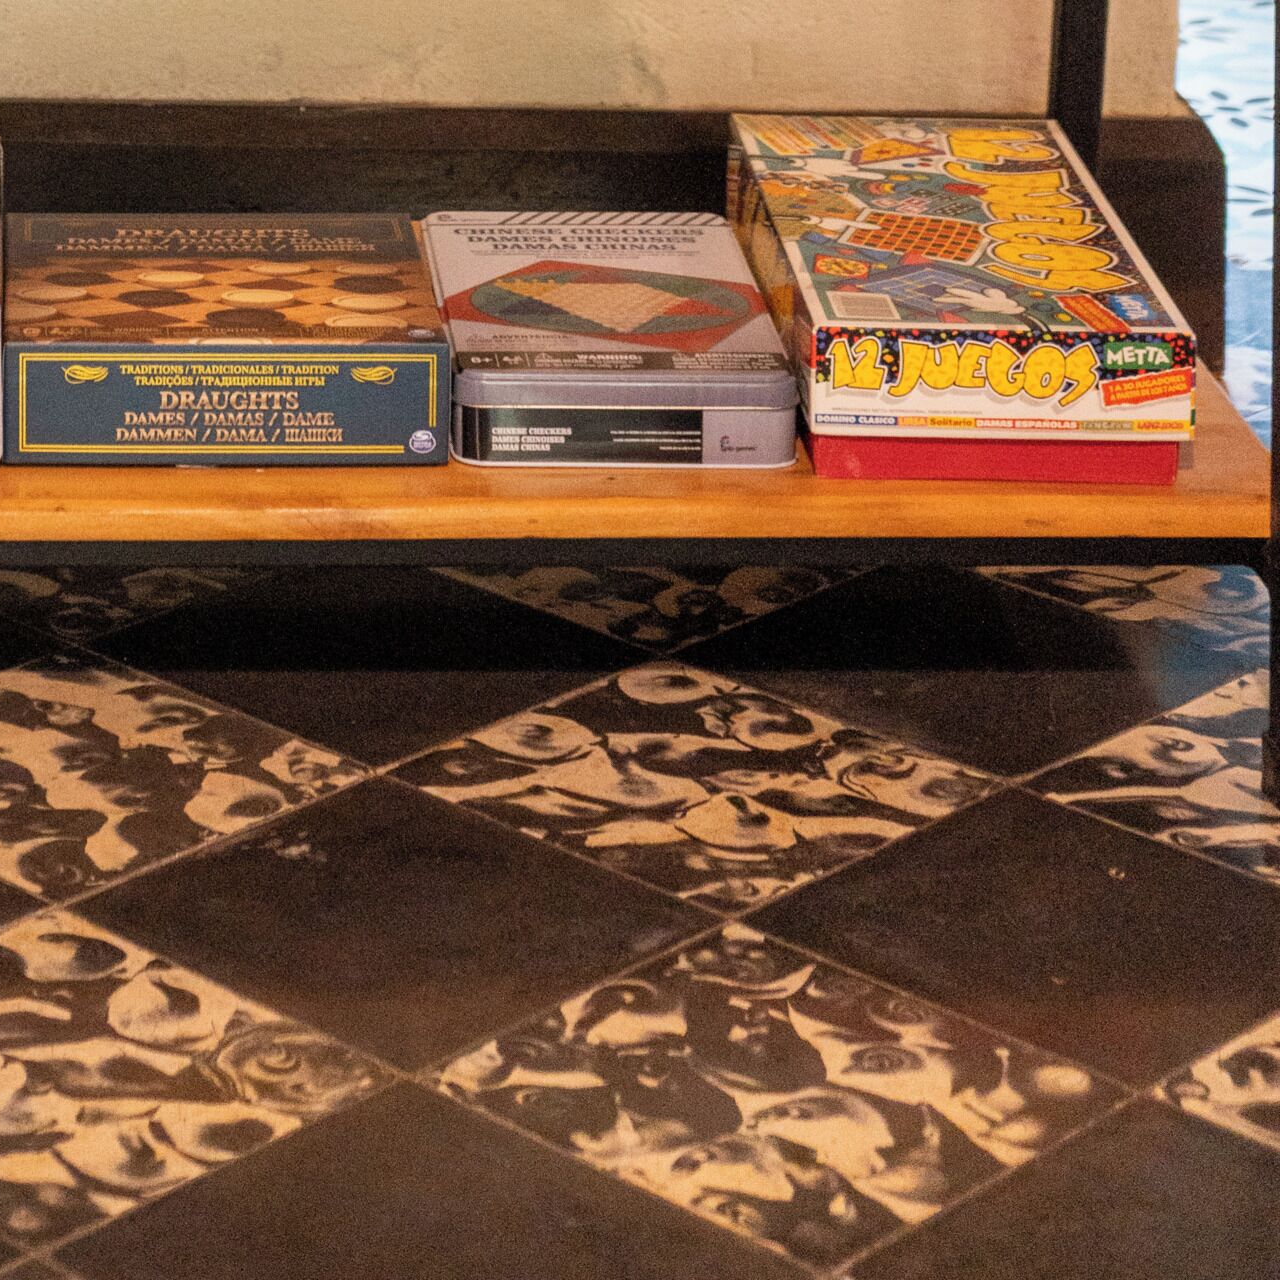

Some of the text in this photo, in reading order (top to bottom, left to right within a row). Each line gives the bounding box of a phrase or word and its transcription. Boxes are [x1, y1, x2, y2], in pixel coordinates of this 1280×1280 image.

[454, 227, 704, 236] CHINESE CHECKERS
[585, 243, 676, 251] CHINAS
[1106, 346, 1170, 366] METTA
[120, 365, 184, 375] TRADITIONS
[192, 365, 274, 375] TRADICIONALES
[282, 366, 339, 375] TRADITION
[830, 339, 1097, 408] 12 JUEGOS
[134, 374, 193, 387] TRADIÇÕES
[294, 377, 325, 386] ИГРЫ
[1136, 374, 1186, 389] JUGADORES
[159, 391, 300, 410] DRAUGHTS
[124, 412, 186, 426] DAMES
[204, 412, 264, 426] DAMAS
[283, 412, 335, 426] DAME
[816, 414, 856, 424] DOMINO
[858, 415, 895, 425] CLASICO
[930, 416, 973, 427] Solitario
[977, 419, 1078, 430] DAMAS ESPAÑOLAS
[116, 428, 197, 442] DAMMEN
[215, 428, 268, 442] DAMA
[285, 428, 343, 442] ШАШКИ
[492, 427, 572, 436] CHINESE CHECKERS
[492, 436, 565, 444] DAMES CHINOISES
